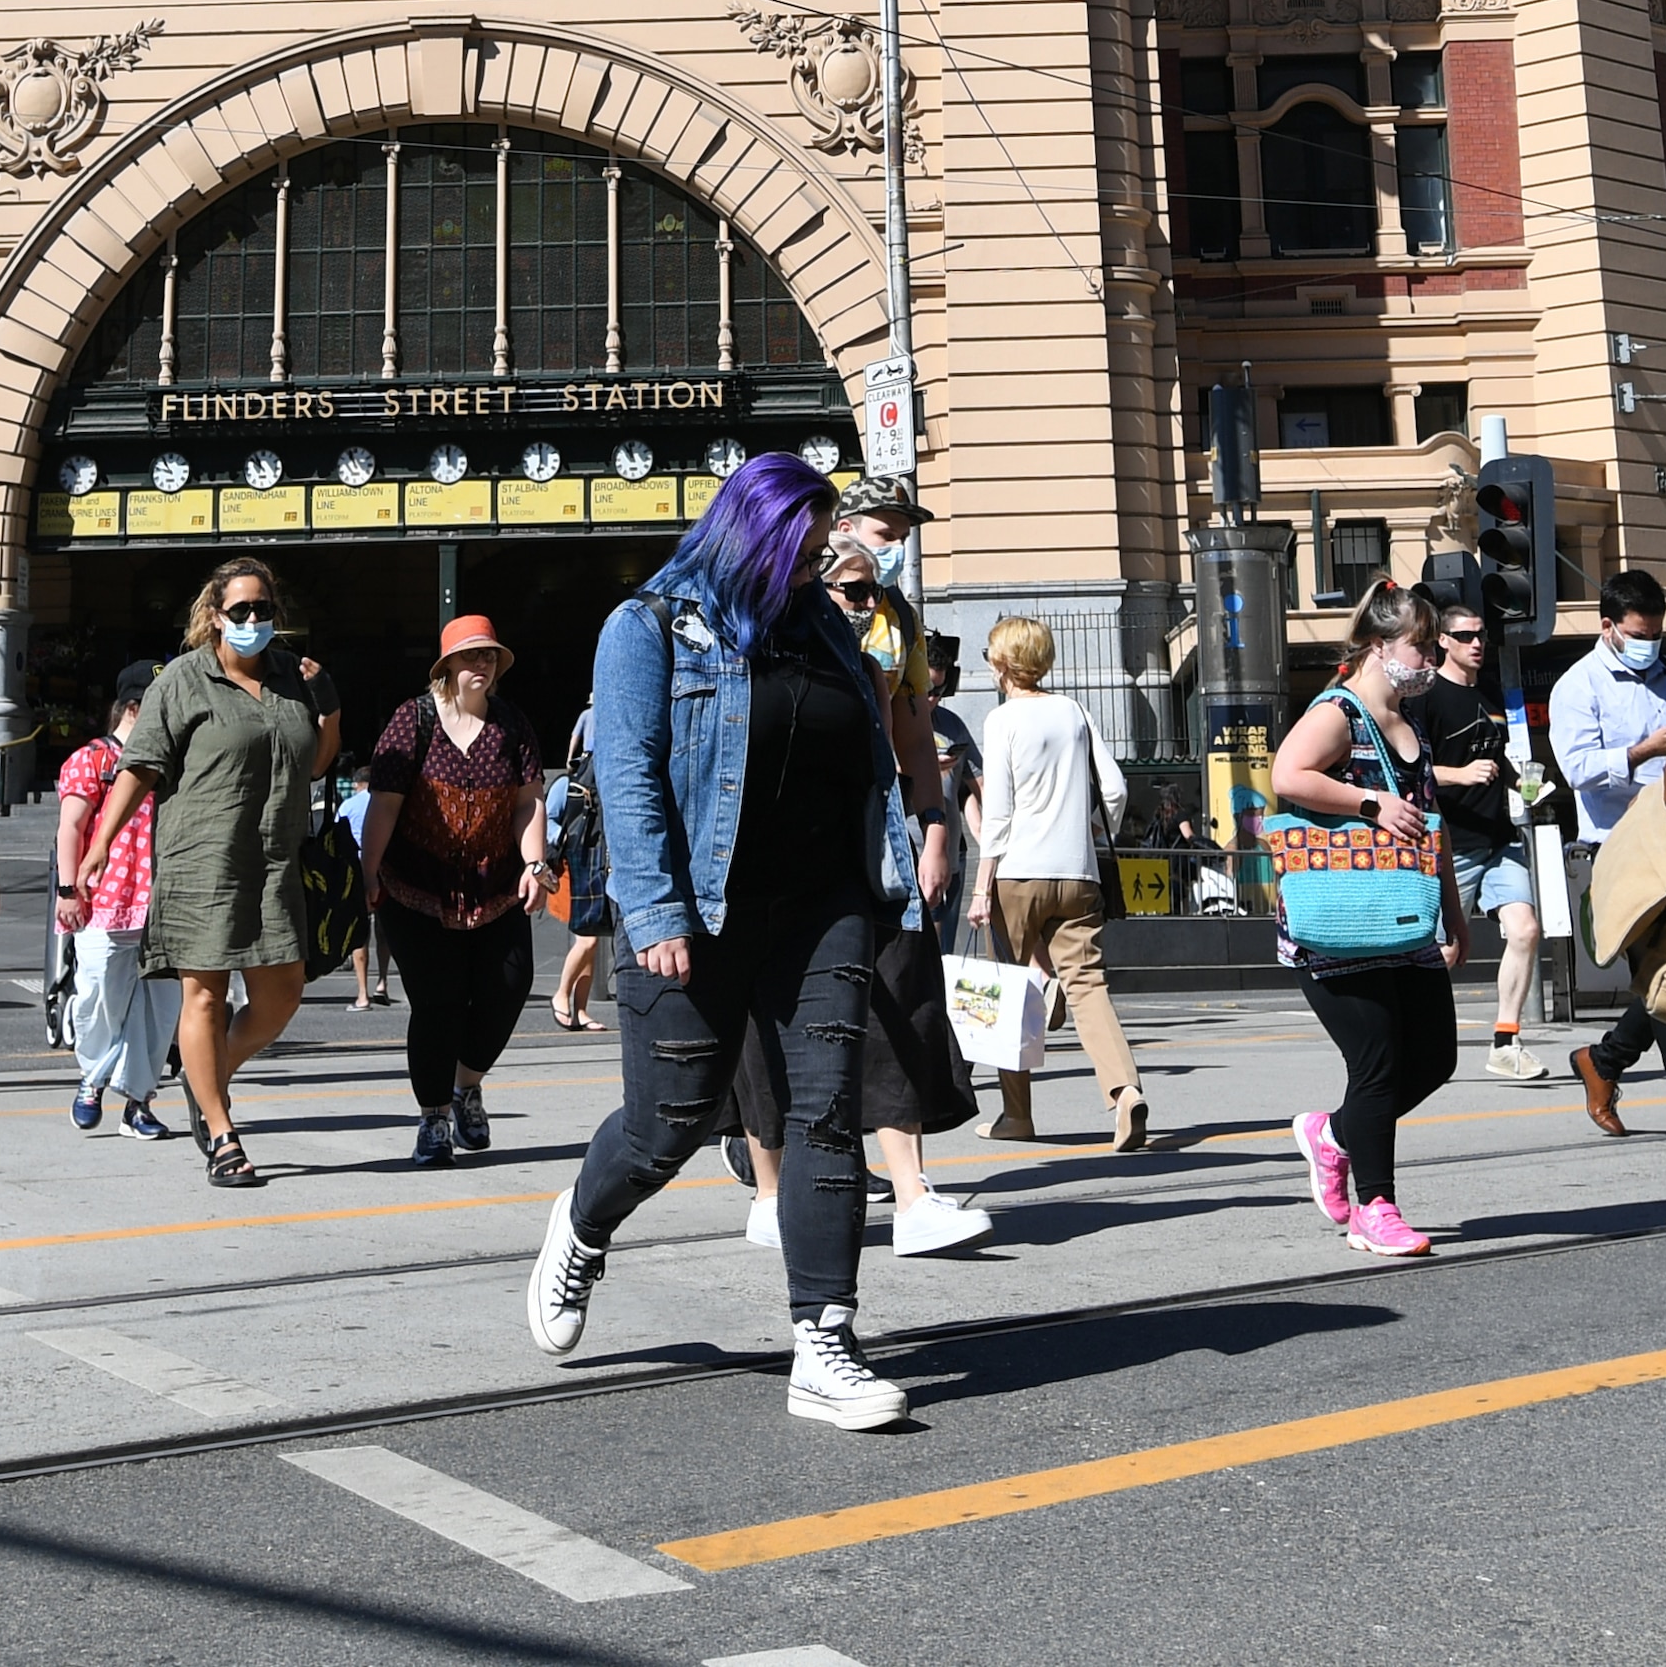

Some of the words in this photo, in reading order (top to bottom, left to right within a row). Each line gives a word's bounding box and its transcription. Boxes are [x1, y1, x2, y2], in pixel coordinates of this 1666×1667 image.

[867, 386, 908, 403] CLEARWAY
[162, 391, 334, 421] FLINDERS
[384, 387, 516, 416] STREET
[563, 381, 723, 412] STATION
[881, 402, 896, 427] C
[409, 485, 443, 494] ALTONA
[502, 484, 513, 493] ST
[515, 484, 549, 493] ALBANS
[594, 480, 669, 491] BROADMEADOWS
[223, 491, 286, 501] SANDRINGHAM
[317, 487, 383, 497] WILLIAMSTOWN
[688, 491, 707, 501] LINE
[40, 496, 82, 505] PAKENHAM
[86, 496, 99, 505] and
[129, 494, 181, 504] FRANKSTON
[408, 498, 428, 506] LINE
[501, 496, 521, 505] LINE
[594, 494, 613, 503] LINE
[223, 504, 242, 513] LINE
[316, 501, 335, 510] LINE
[95, 507, 117, 517] LINES
[128, 506, 147, 516] LINE
[1222, 726, 1267, 735] WEAR
[1214, 736, 1223, 745] A
[1224, 736, 1267, 745] MASK
[1237, 745, 1268, 754] AND
